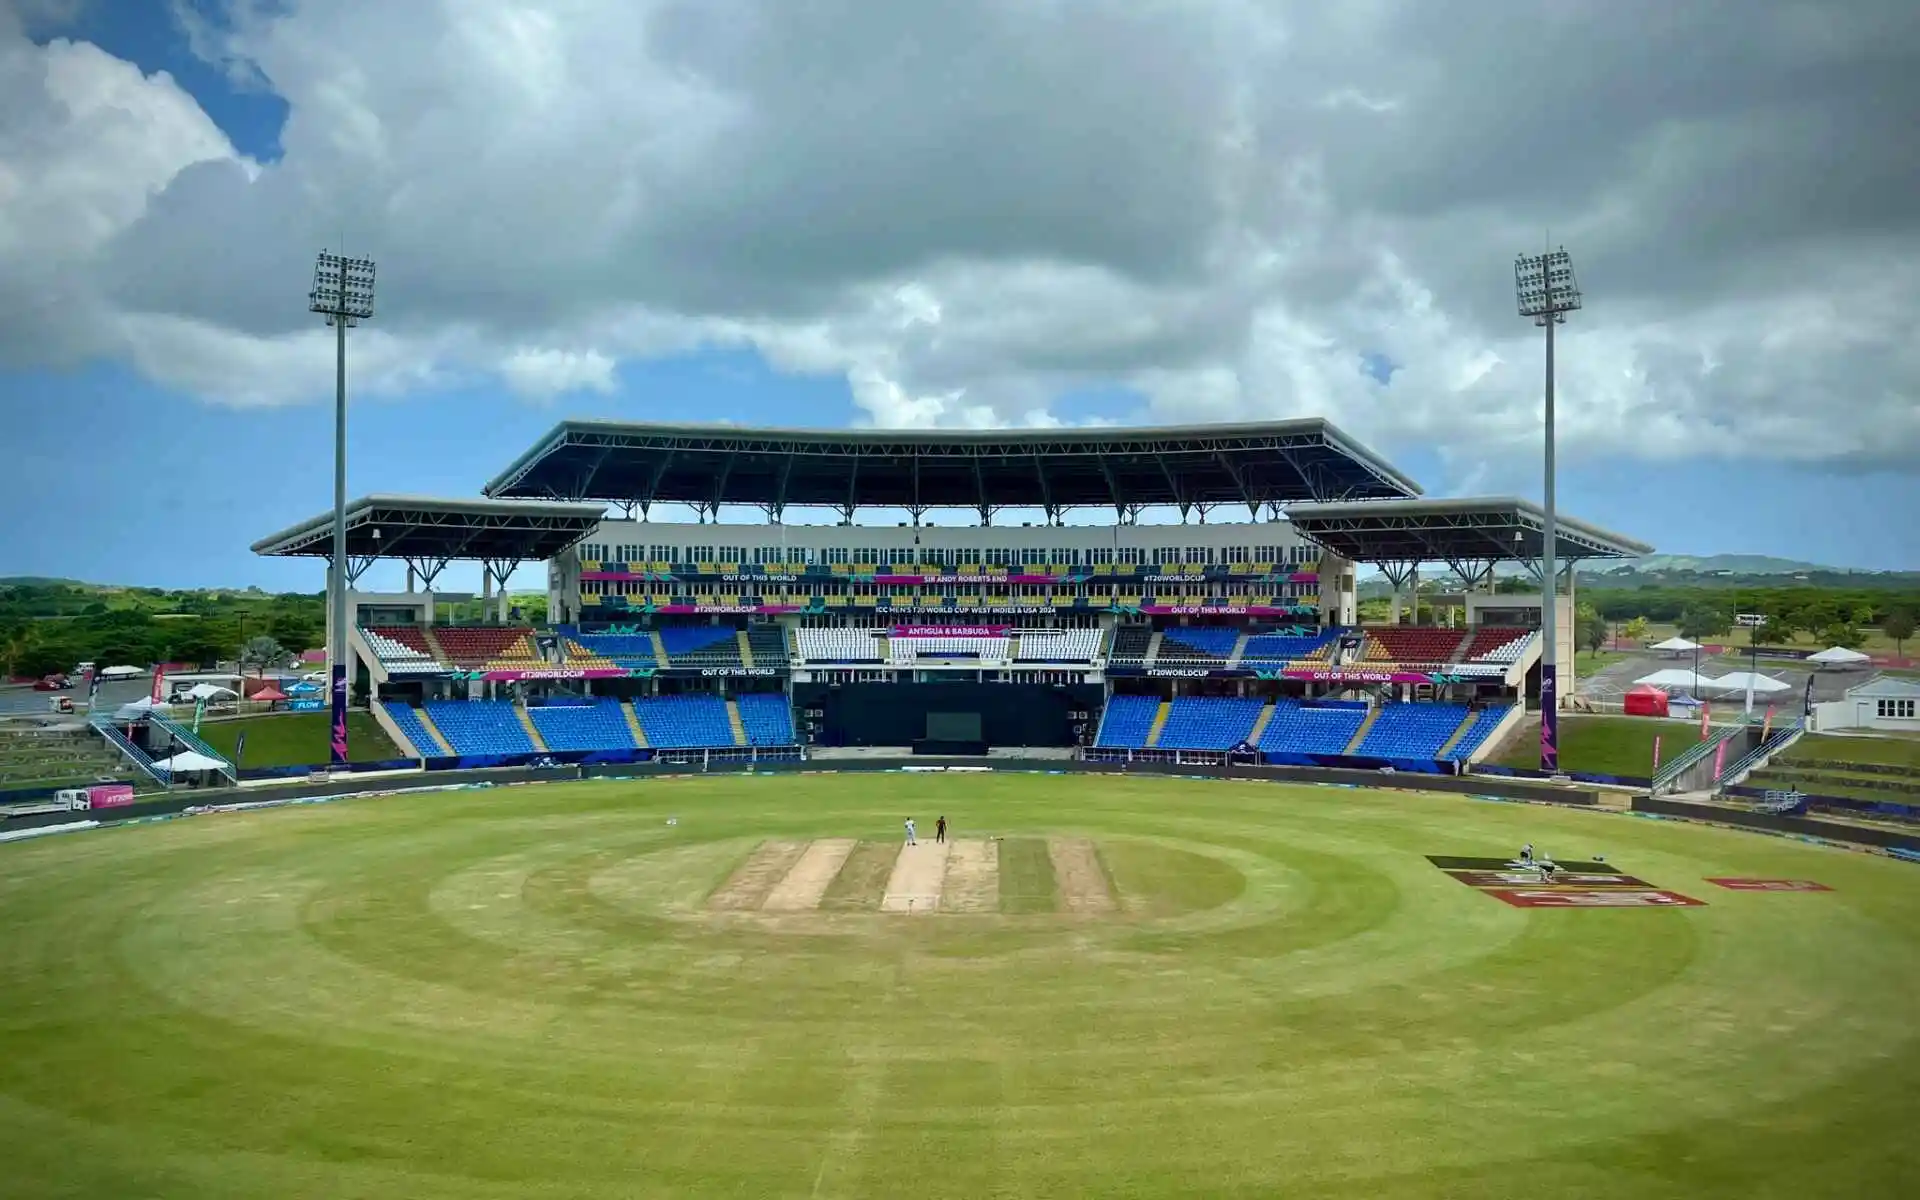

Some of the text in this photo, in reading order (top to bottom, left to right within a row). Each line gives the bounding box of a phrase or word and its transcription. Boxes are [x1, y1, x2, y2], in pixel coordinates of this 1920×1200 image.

[923, 575, 1008, 583] SIR ANDY ROBERTS END
[694, 605, 757, 613] #T20WORLDCUP
[971, 606, 991, 614] WEST
[992, 606, 1016, 614] INDIES
[1023, 606, 1037, 614] USA
[1039, 606, 1056, 614] 2024
[1171, 606, 1247, 614] OUT OF THIS WORLD
[908, 627, 990, 635] ANTIGUA & BARBUDA
[520, 670, 585, 679] #T20WORLDCUP
[702, 668, 776, 676] OUT OF THIS WORLD
[1147, 668, 1209, 677] #T20WORLDCUP
[1313, 672, 1392, 680] OUT OF THIS WORLD
